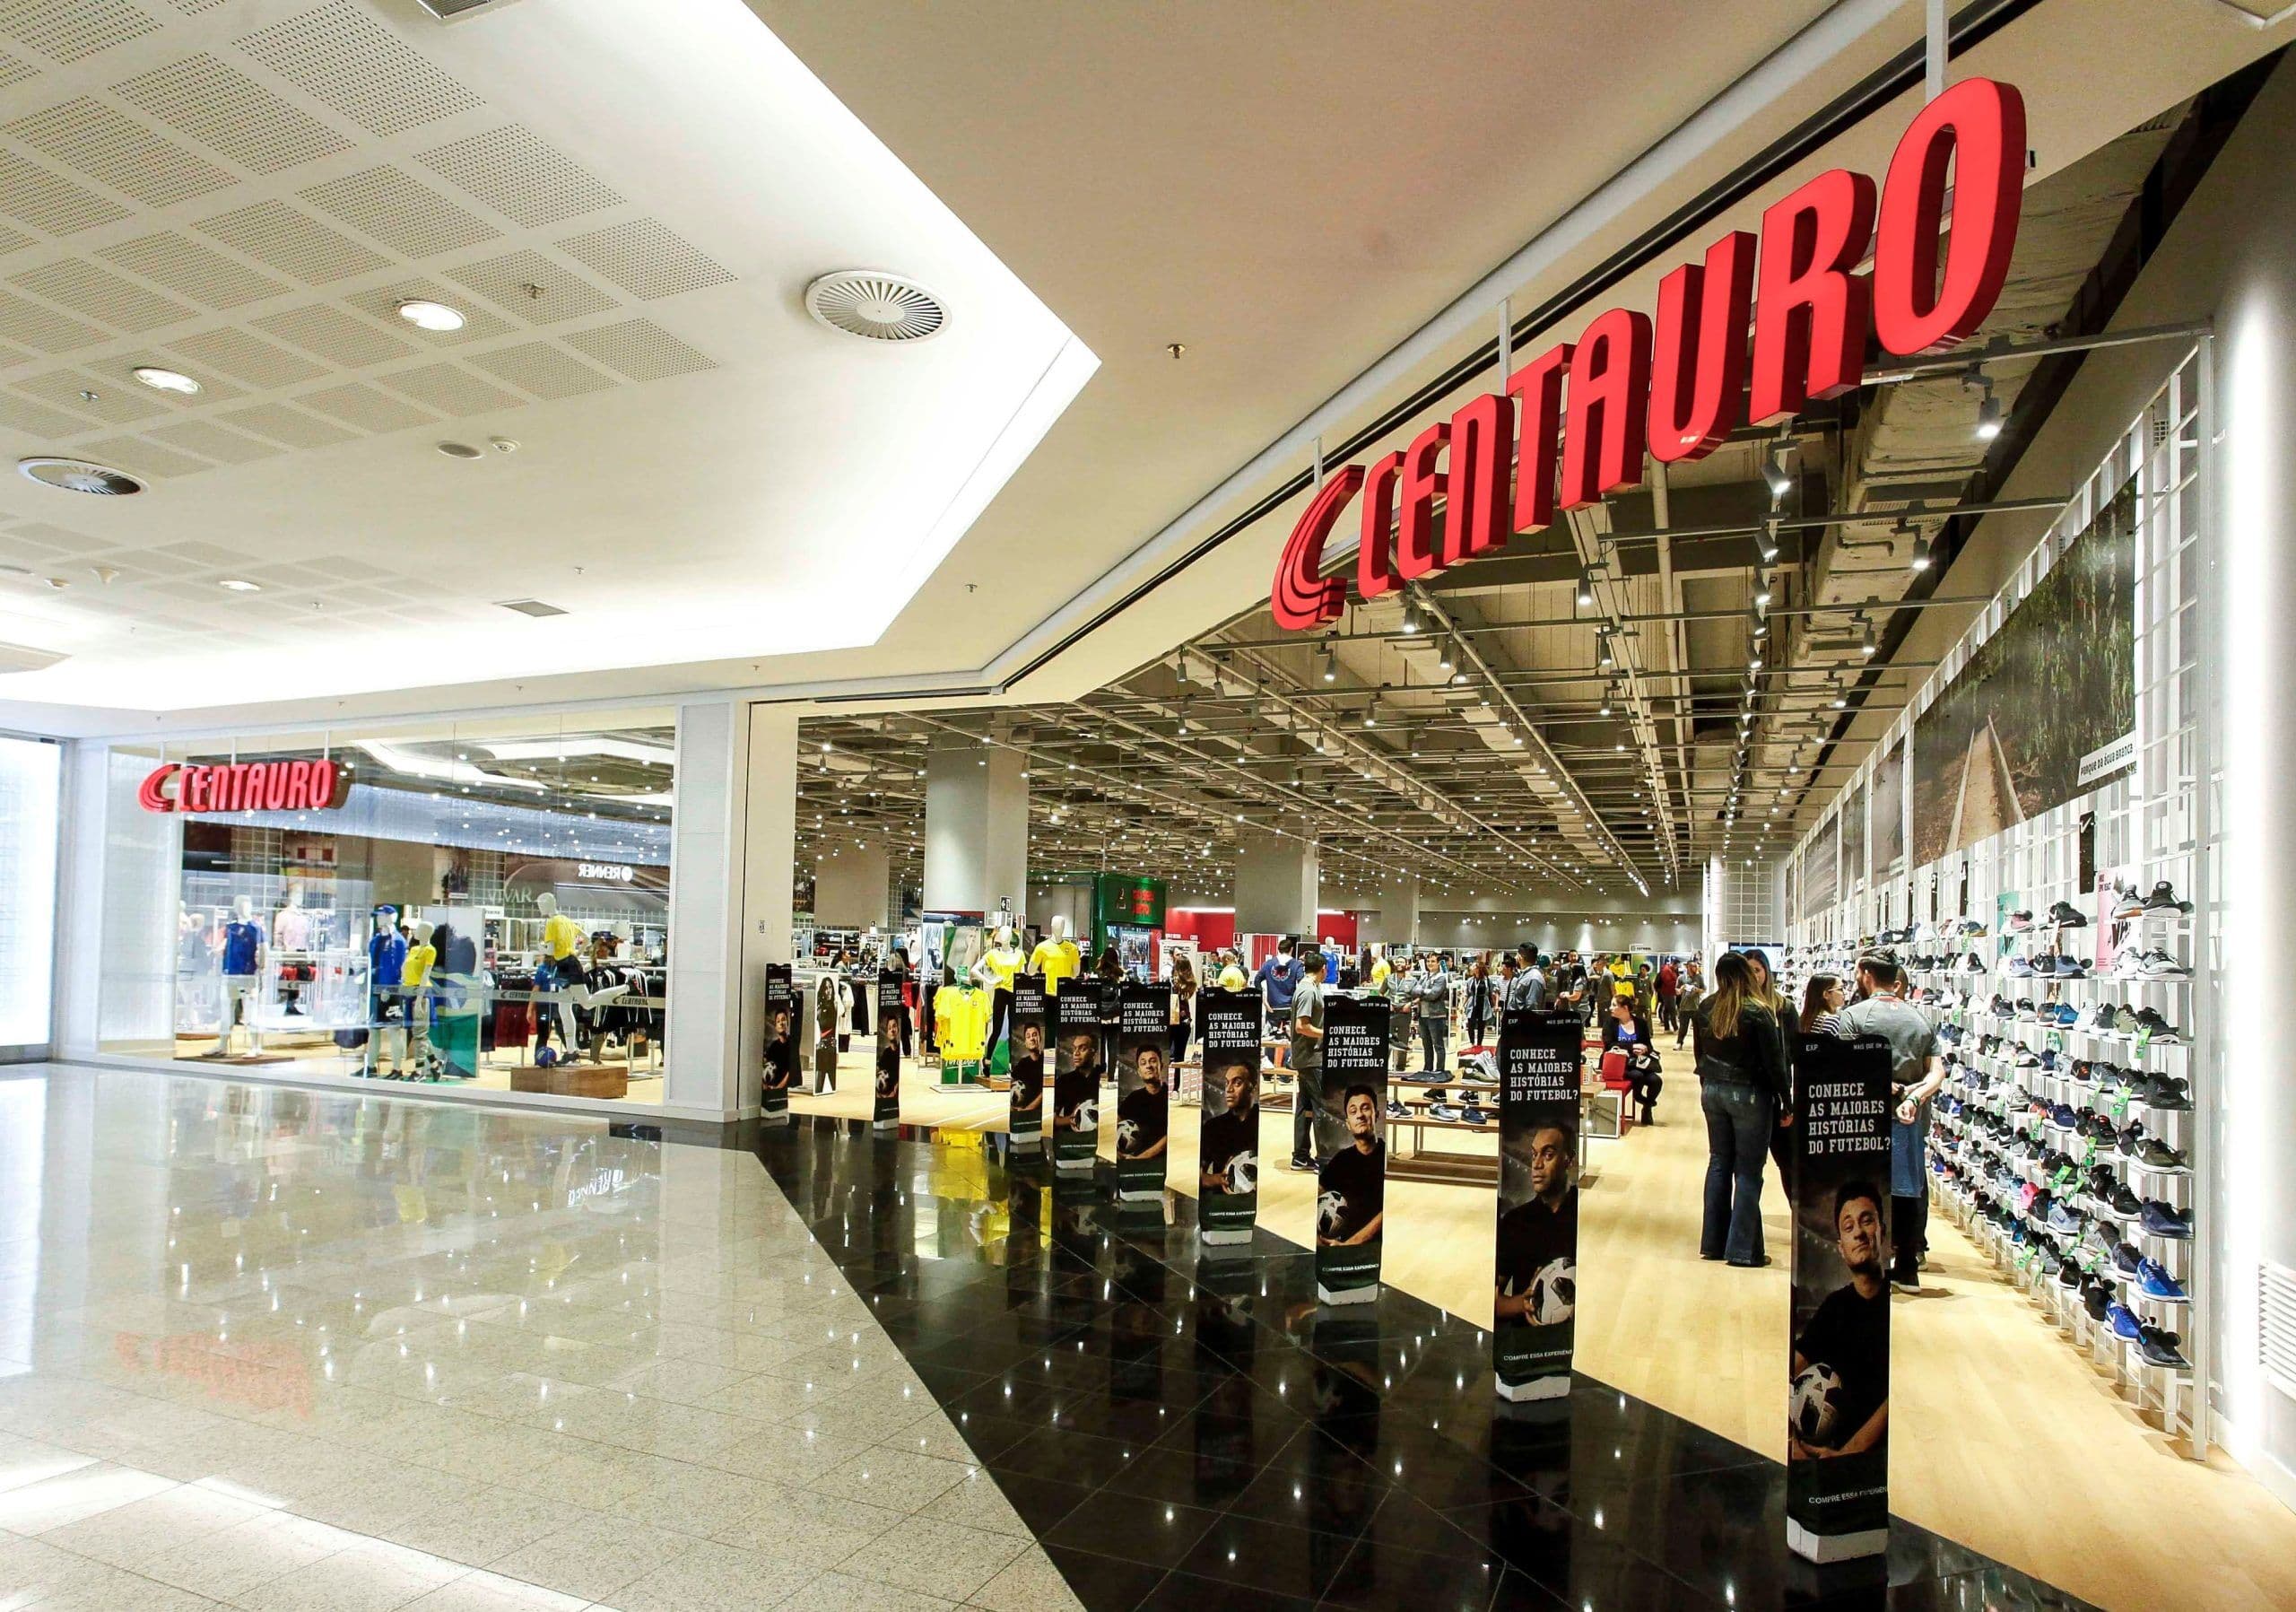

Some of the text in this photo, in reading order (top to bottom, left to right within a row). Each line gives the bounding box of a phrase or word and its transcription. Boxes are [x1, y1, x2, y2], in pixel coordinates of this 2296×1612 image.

[1357, 77, 2026, 600] CENTAURO
[179, 759, 336, 812] CENTAURO
[1209, 1030, 1248, 1039] HISTÓRIAS
[1329, 1026, 1367, 1034] CONHECE
[1221, 1040, 1258, 1048] FUTEBOL?
[1329, 1037, 1380, 1045] AS MAIORES
[1328, 1046, 1373, 1057] HISTÓRIAS
[1510, 1049, 1556, 1059] CONHECE
[1327, 1059, 1384, 1067] DO FUTEBOL?
[1510, 1062, 1573, 1073] AS MAIORES
[1510, 1074, 1564, 1087] HISTÓRIAS
[1510, 1089, 1578, 1101] DO FUTEBOL?
[1808, 1083, 1865, 1098] CONHECE
[1808, 1101, 1884, 1117] AS MAIORES
[1808, 1116, 1874, 1136] HISTÓRIAS
[1808, 1137, 1891, 1154] DO FUTEBOL?
[1808, 1494, 1841, 1503] COMPRE
